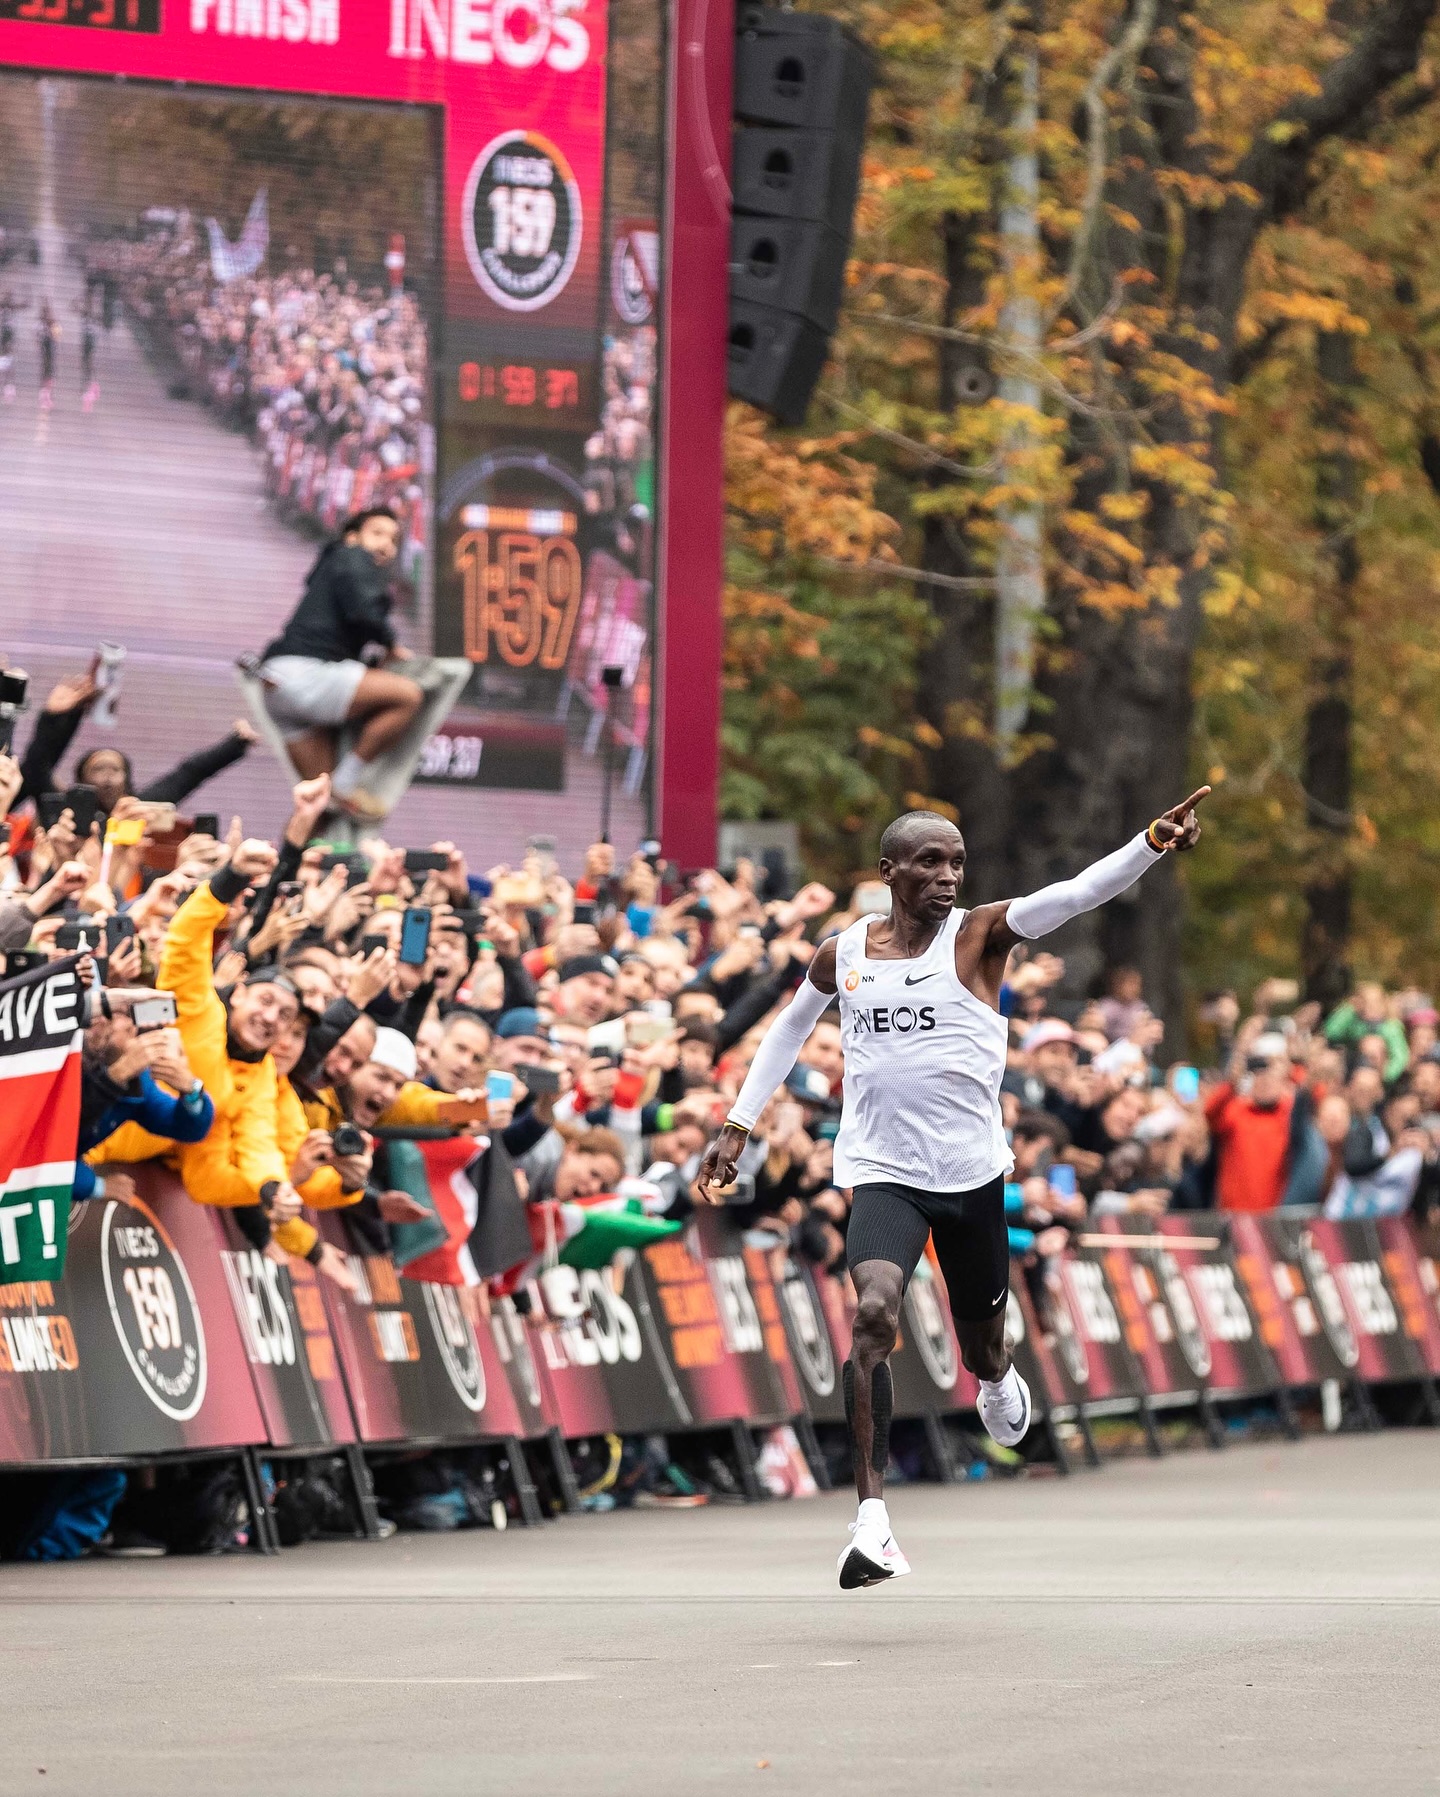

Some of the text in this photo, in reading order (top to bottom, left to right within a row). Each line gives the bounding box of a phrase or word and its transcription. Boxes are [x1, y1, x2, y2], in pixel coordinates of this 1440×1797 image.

[388, 0, 591, 72] INEOS
[455, 530, 583, 669] 1:59
[862, 975, 875, 983] NN
[852, 1006, 936, 1034] INEOS
